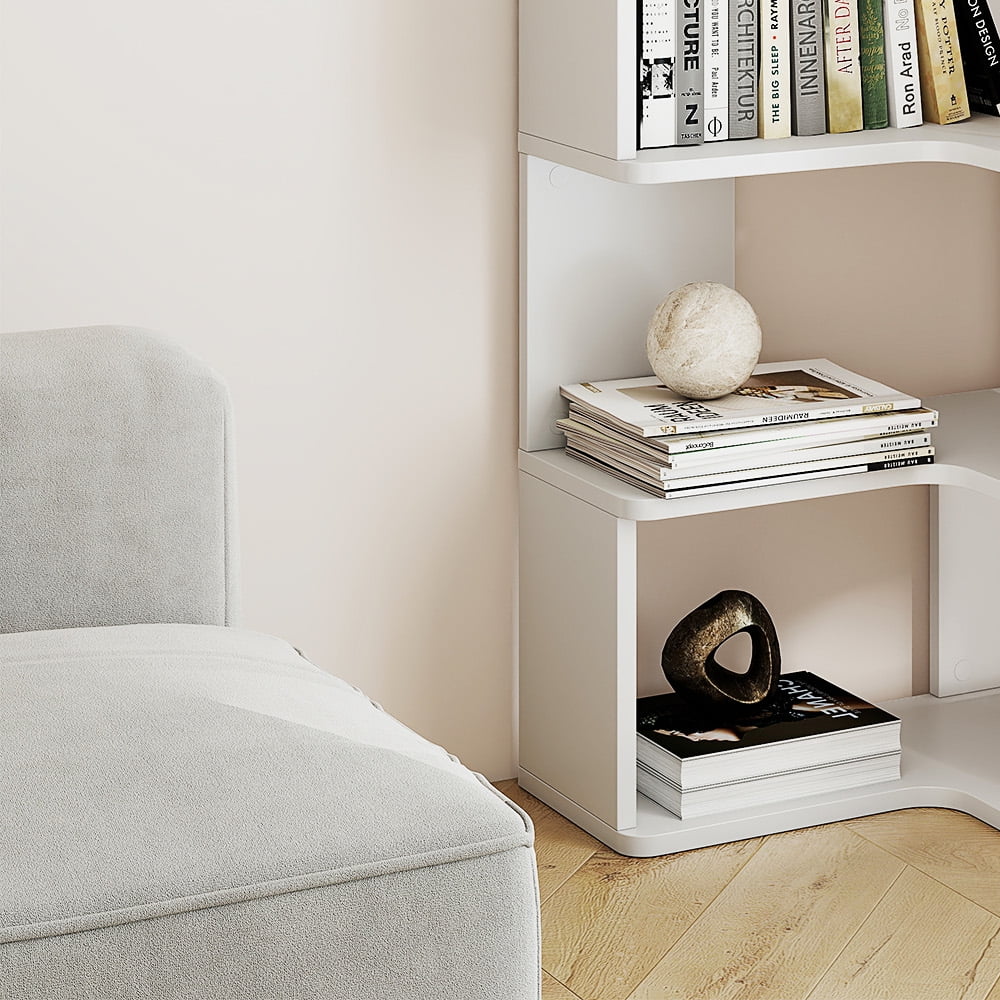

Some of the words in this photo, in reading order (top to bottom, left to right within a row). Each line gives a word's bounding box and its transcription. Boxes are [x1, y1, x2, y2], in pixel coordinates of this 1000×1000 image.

[711, 8, 719, 20] YOU
[894, 9, 910, 31] No
[711, 22, 719, 37] WANT
[711, 39, 719, 47] TO
[835, 25, 854, 74] AFTER
[941, 16, 956, 75] POTTER
[975, 19, 1000, 68] DESIGN
[770, 45, 779, 75] SLEEP
[898, 42, 914, 78] Arad
[938, 45, 947, 75] PRINCE
[711, 67, 719, 80] Paul
[711, 81, 719, 98] Arden
[771, 80, 780, 98] BIG
[900, 84, 916, 115] Ron
[771, 103, 780, 124] THE
[762, 412, 809, 423] RAUMIDEEN
[685, 441, 714, 451] BoConcept
